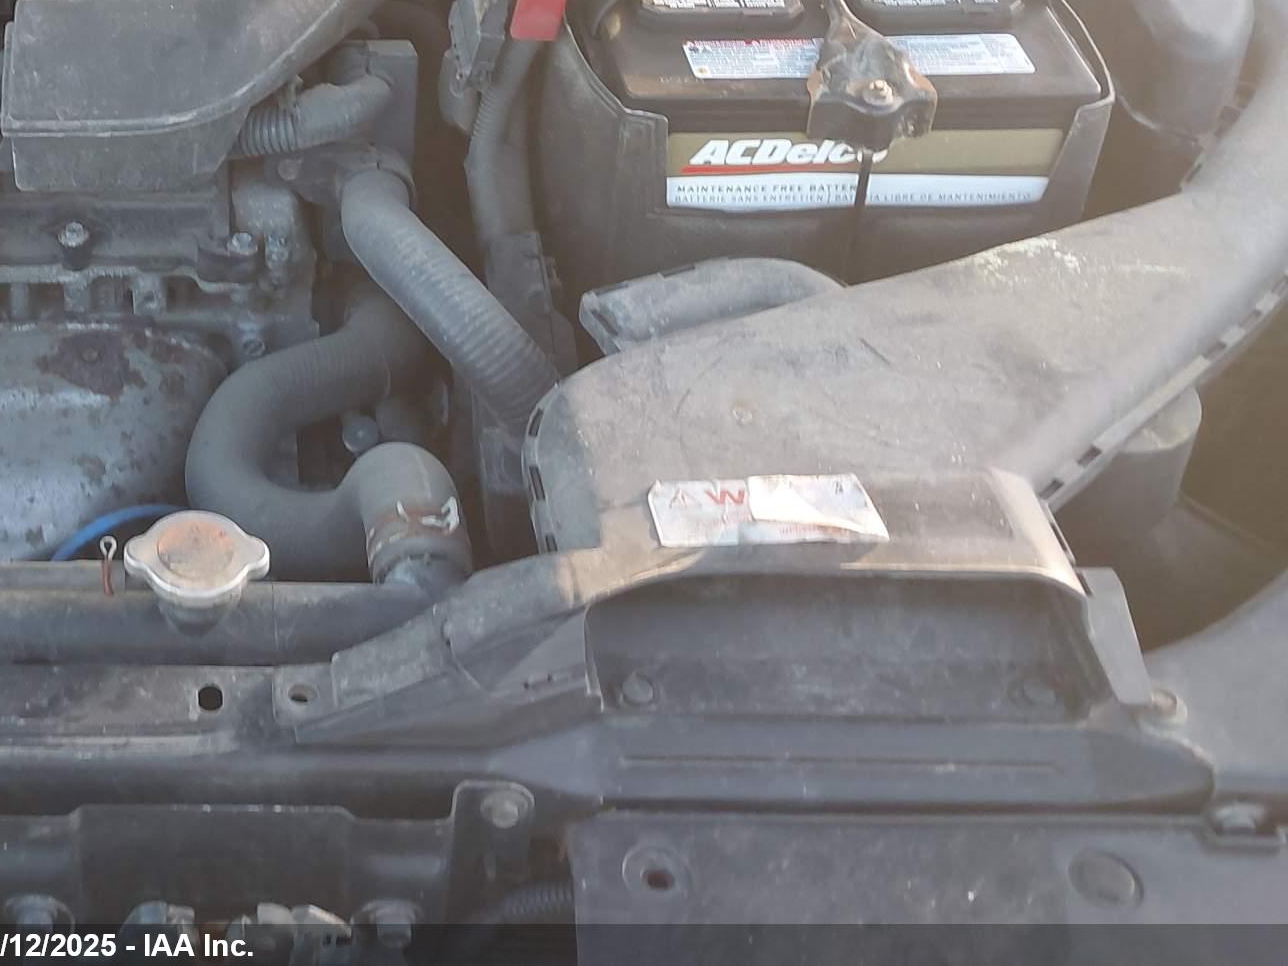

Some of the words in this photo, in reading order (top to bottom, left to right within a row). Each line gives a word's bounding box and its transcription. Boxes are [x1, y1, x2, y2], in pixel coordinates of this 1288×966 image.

[677, 184, 765, 193] MAINTENANCE
[772, 184, 802, 193] FREE
[809, 183, 856, 193] BATTER
